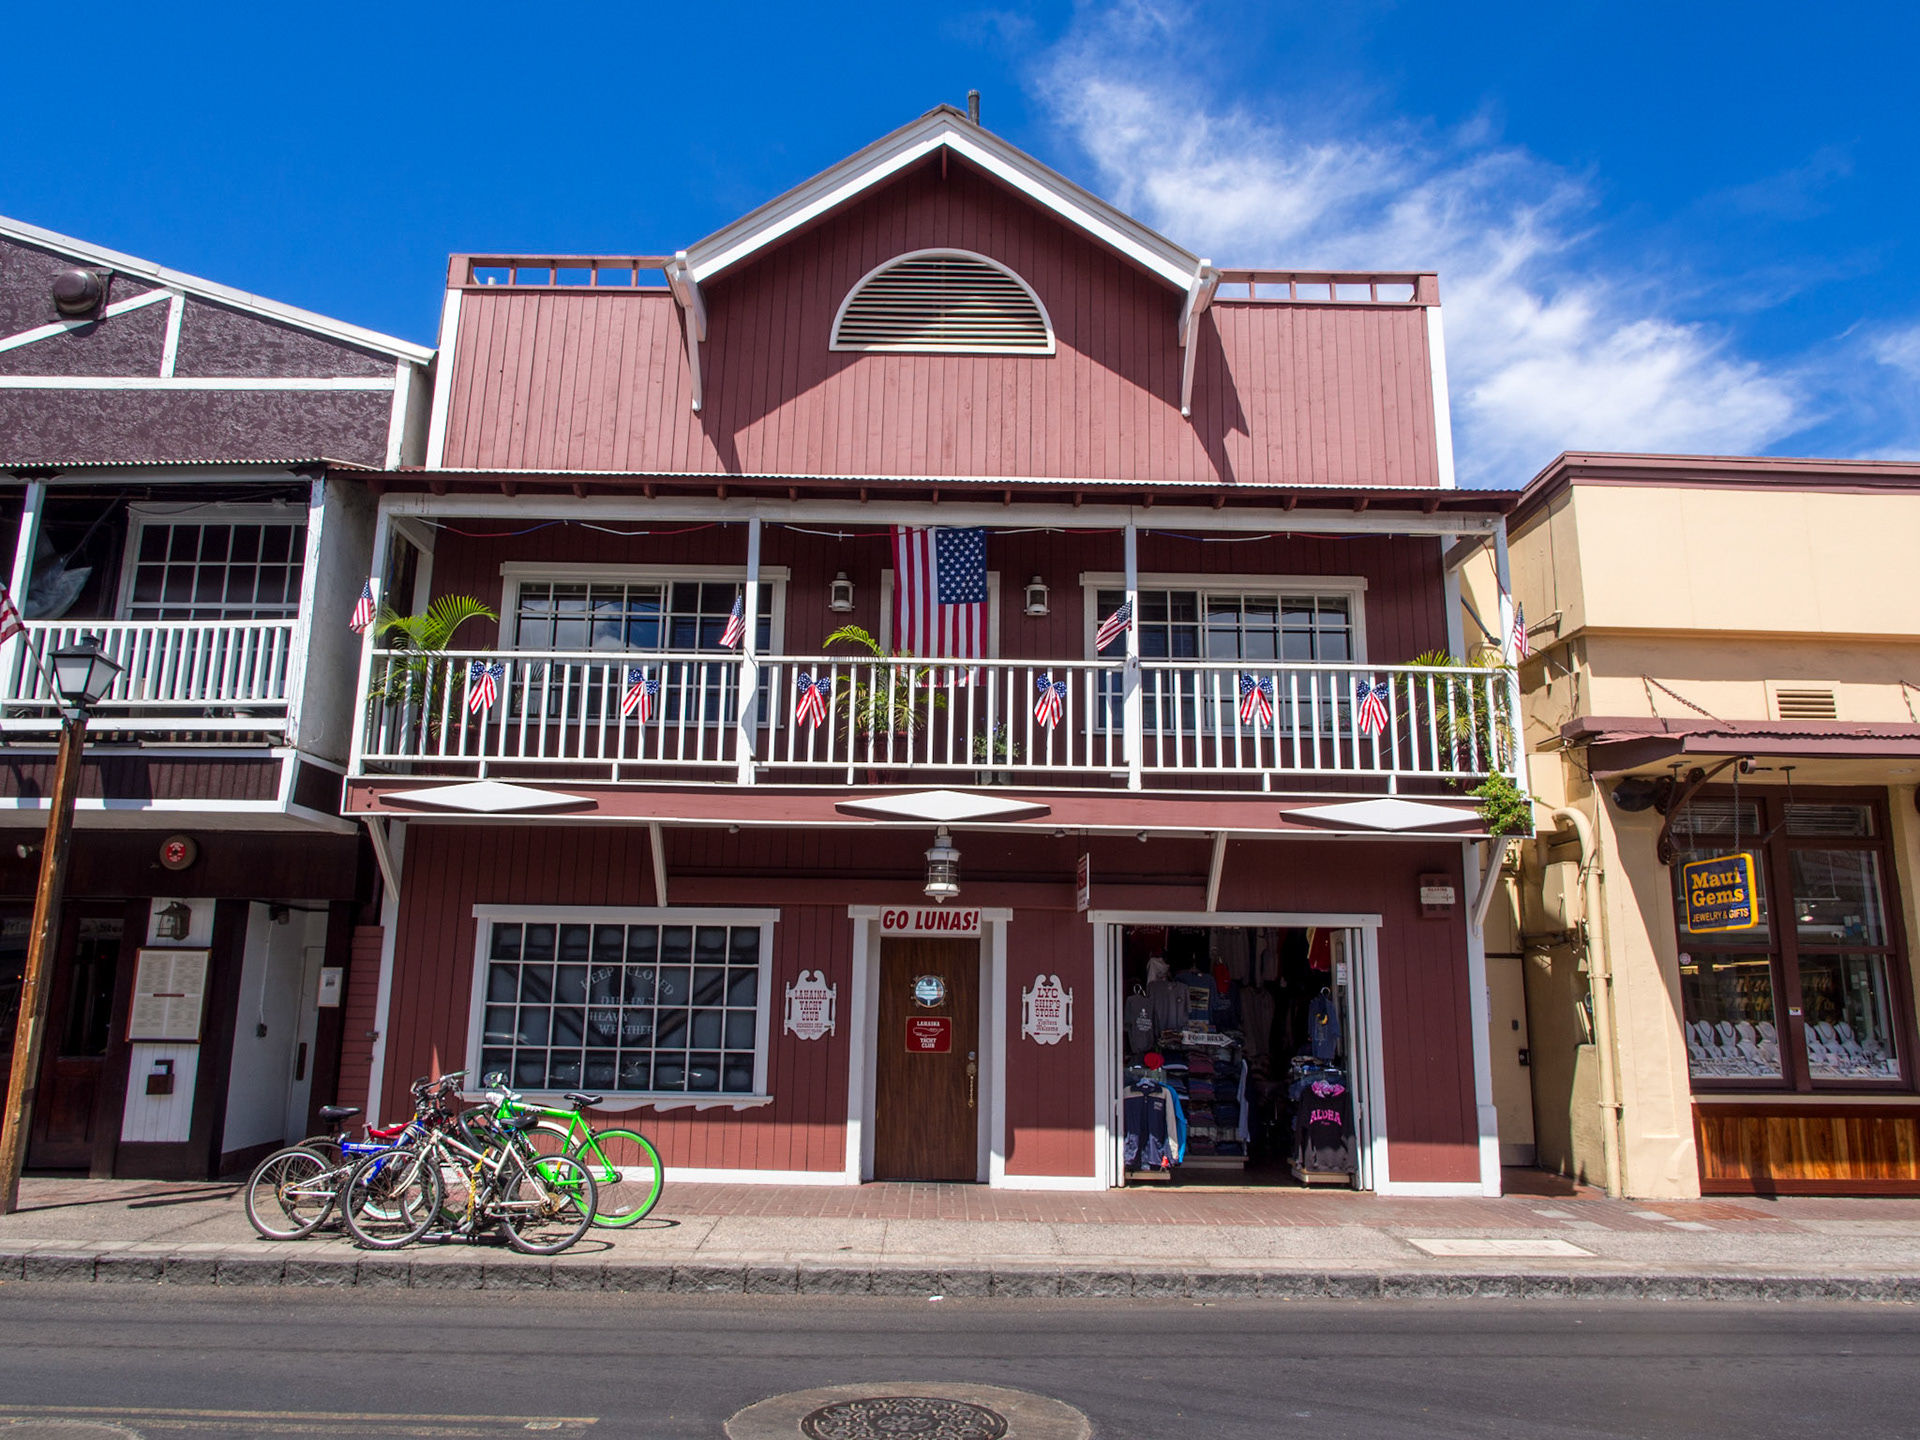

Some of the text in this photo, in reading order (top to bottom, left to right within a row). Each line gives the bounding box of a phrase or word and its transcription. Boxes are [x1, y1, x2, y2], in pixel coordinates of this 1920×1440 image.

[1691, 866, 1742, 890] Maui
[1692, 888, 1745, 907] Gems
[1692, 907, 1750, 923] JEWELRY & GIFTS
[883, 910, 979, 931] GO LUNAS!
[795, 990, 827, 1000] LAHAINA
[1037, 988, 1058, 998] LYC
[800, 1001, 822, 1010] YACHT
[1035, 999, 1060, 1008] SHIP'S
[589, 1010, 630, 1021] HEAVY
[802, 1011, 818, 1020] CLUB
[1036, 1008, 1059, 1018] STORE
[1310, 1109, 1342, 1126] ALOHA
